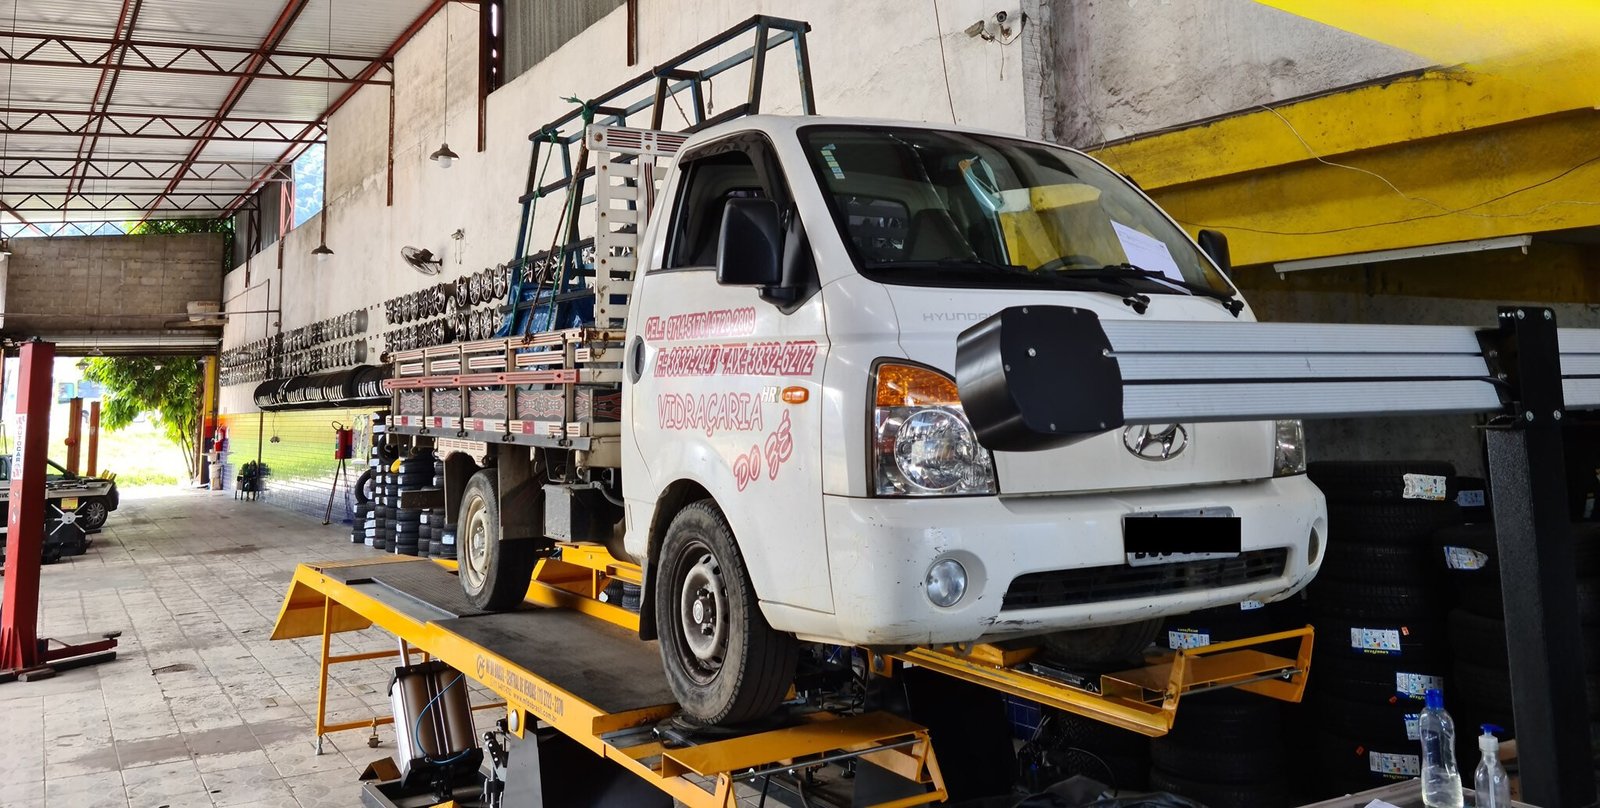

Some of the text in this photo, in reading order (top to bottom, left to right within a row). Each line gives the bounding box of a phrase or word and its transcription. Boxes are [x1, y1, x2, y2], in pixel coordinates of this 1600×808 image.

[922, 312, 992, 321] HYUNDA
[657, 392, 763, 437] VIDRAÇARIA
[733, 444, 761, 492] DO
